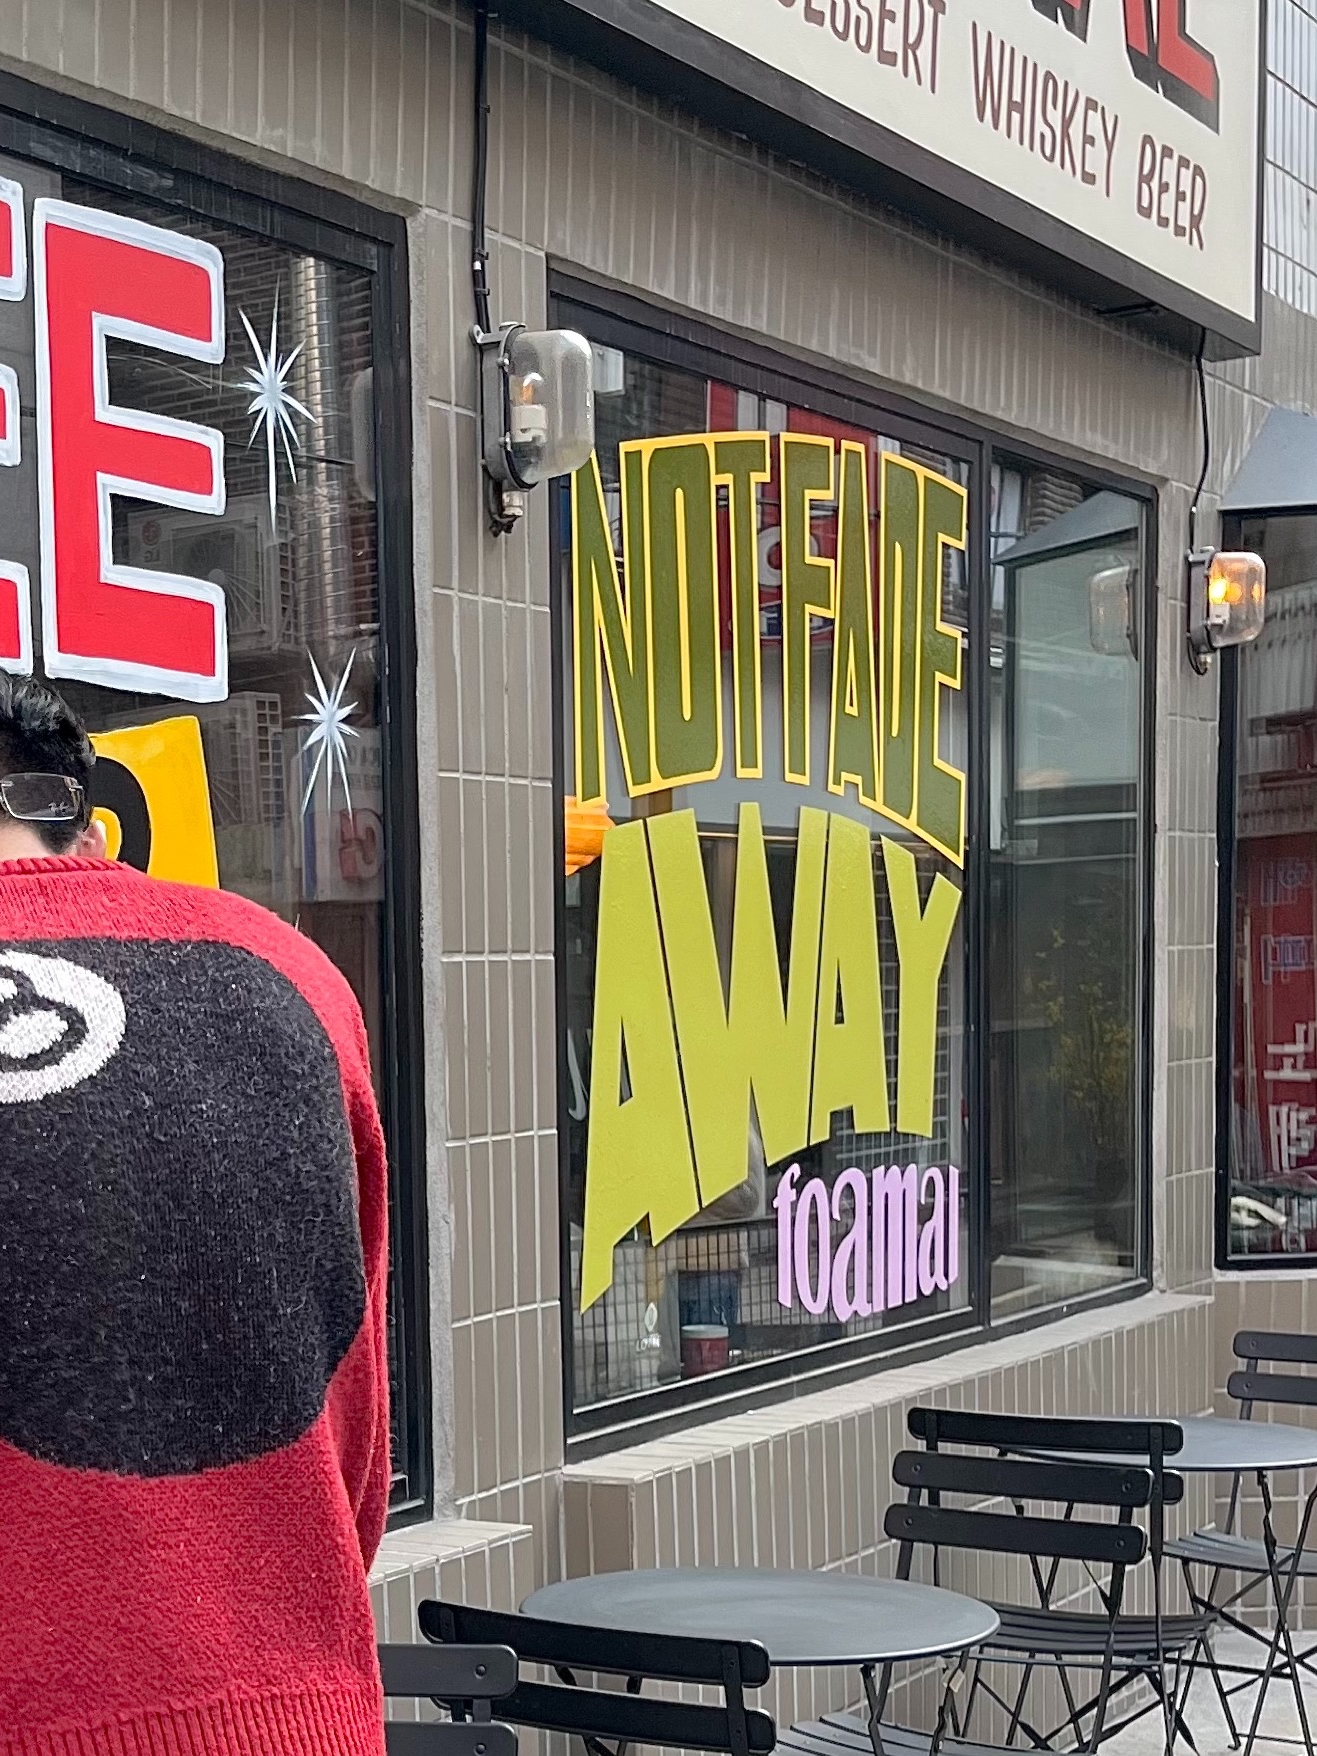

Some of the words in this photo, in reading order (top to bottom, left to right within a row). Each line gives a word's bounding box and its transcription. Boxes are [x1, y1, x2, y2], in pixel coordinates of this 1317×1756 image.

[971, 20, 1120, 199] WHISKEY
[1137, 133, 1207, 251] BEER
[570, 430, 770, 804] NOT
[779, 430, 969, 871] FADE
[580, 801, 962, 1312] AWAY
